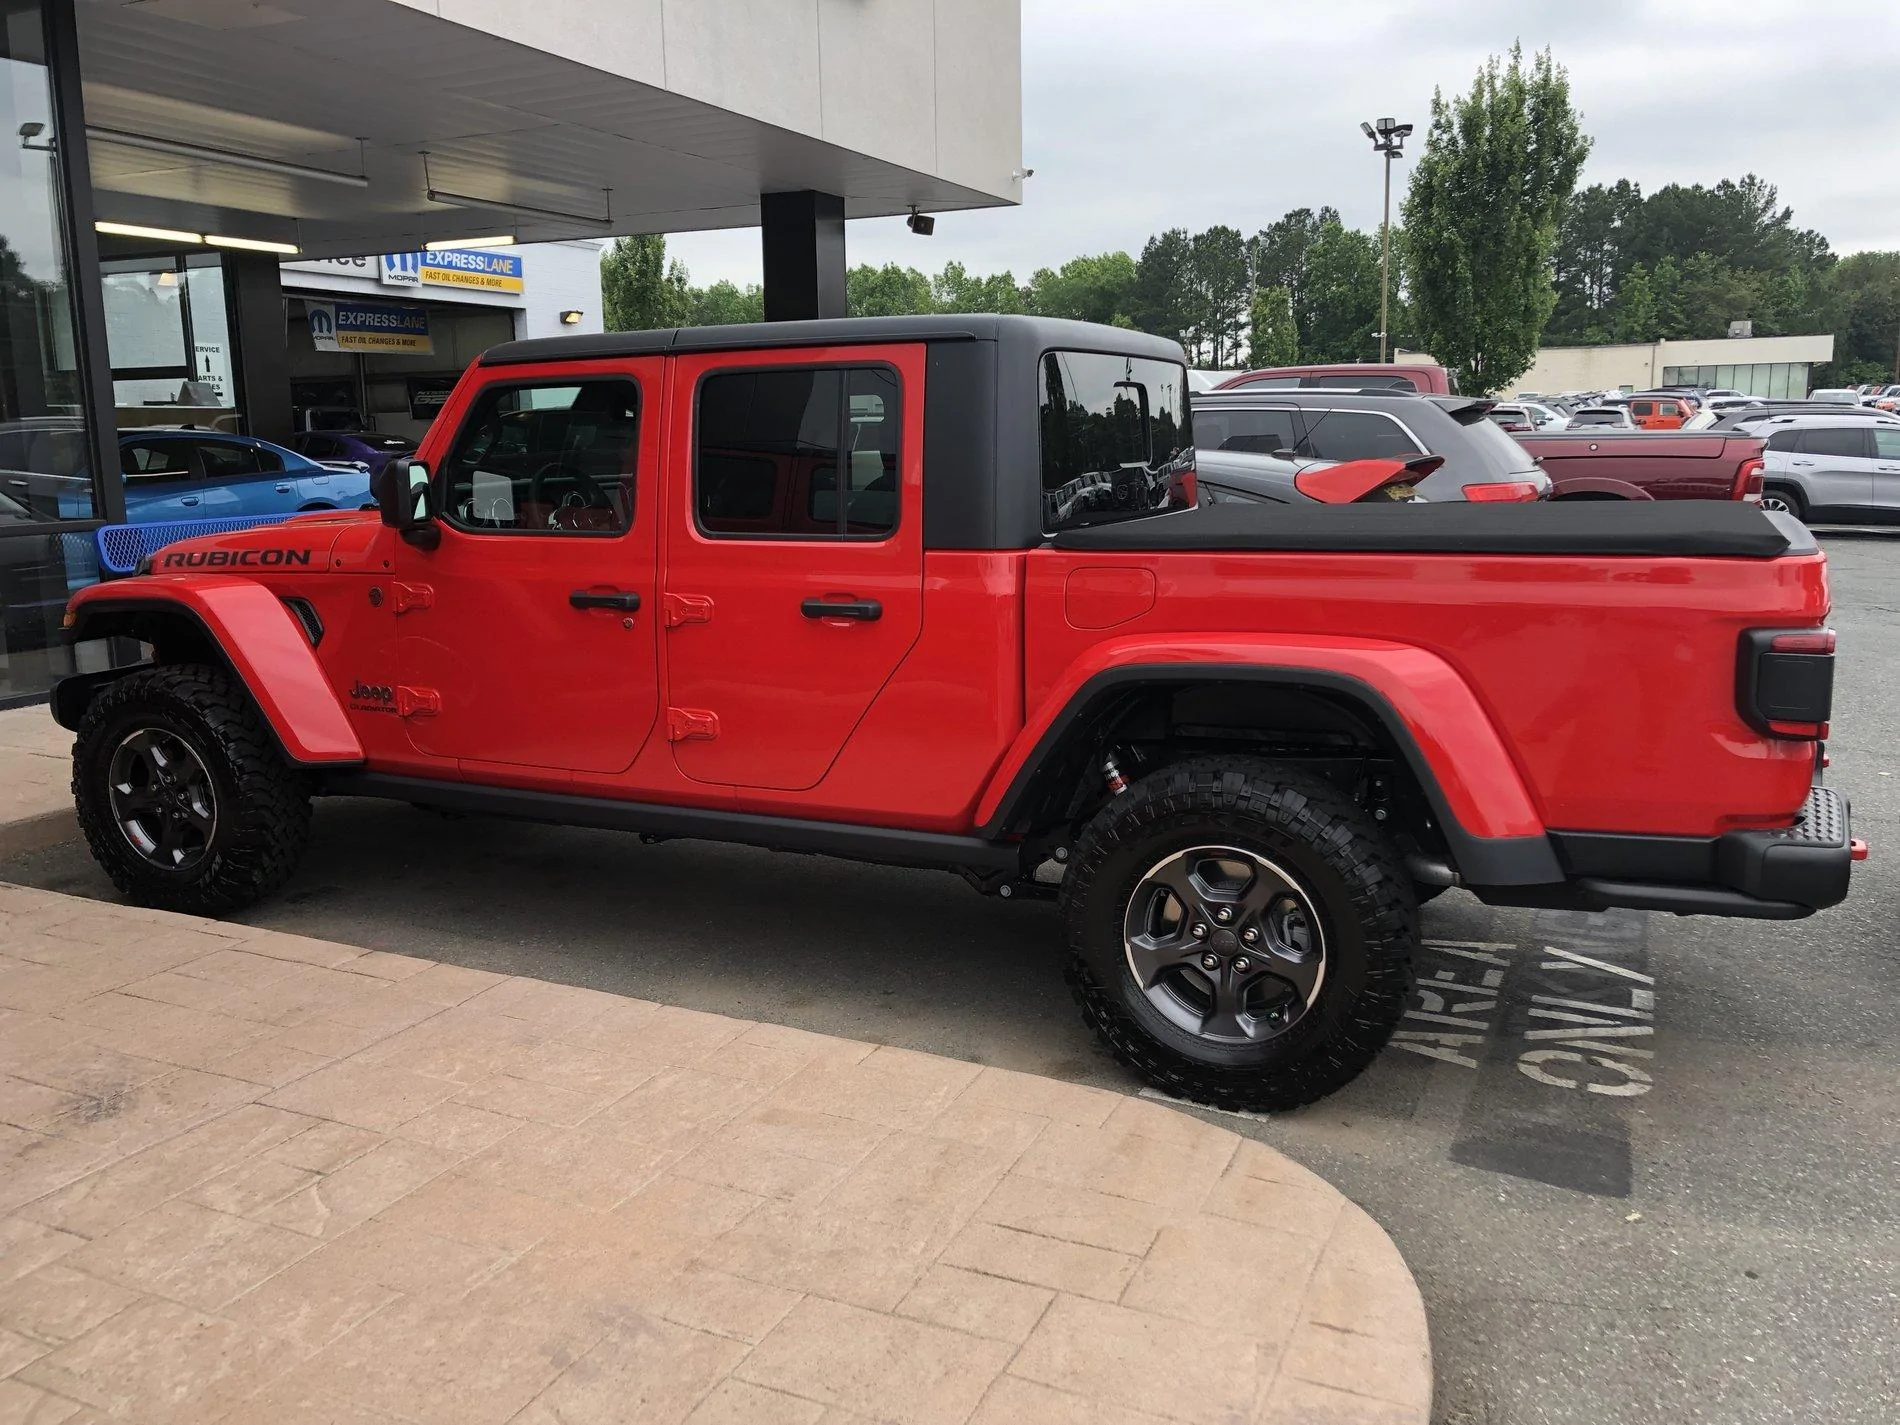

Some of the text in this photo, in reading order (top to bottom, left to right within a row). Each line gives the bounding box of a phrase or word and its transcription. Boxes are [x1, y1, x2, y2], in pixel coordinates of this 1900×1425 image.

[426, 250, 513, 274] EXPRESSLANE
[388, 273, 419, 283] MOPAR
[425, 270, 503, 287] FAST OIL CHANGES & MORE
[338, 311, 425, 329] EXPRESSLANE
[341, 335, 357, 344] FAST
[357, 336, 367, 344] OIL
[368, 336, 396, 346] CHANGES
[401, 338, 417, 347] MORE
[164, 549, 311, 568] RUBICON
[349, 680, 393, 704] Jeep
[1387, 938, 1517, 1069] AREA
[1516, 945, 1655, 1097] ONLY
